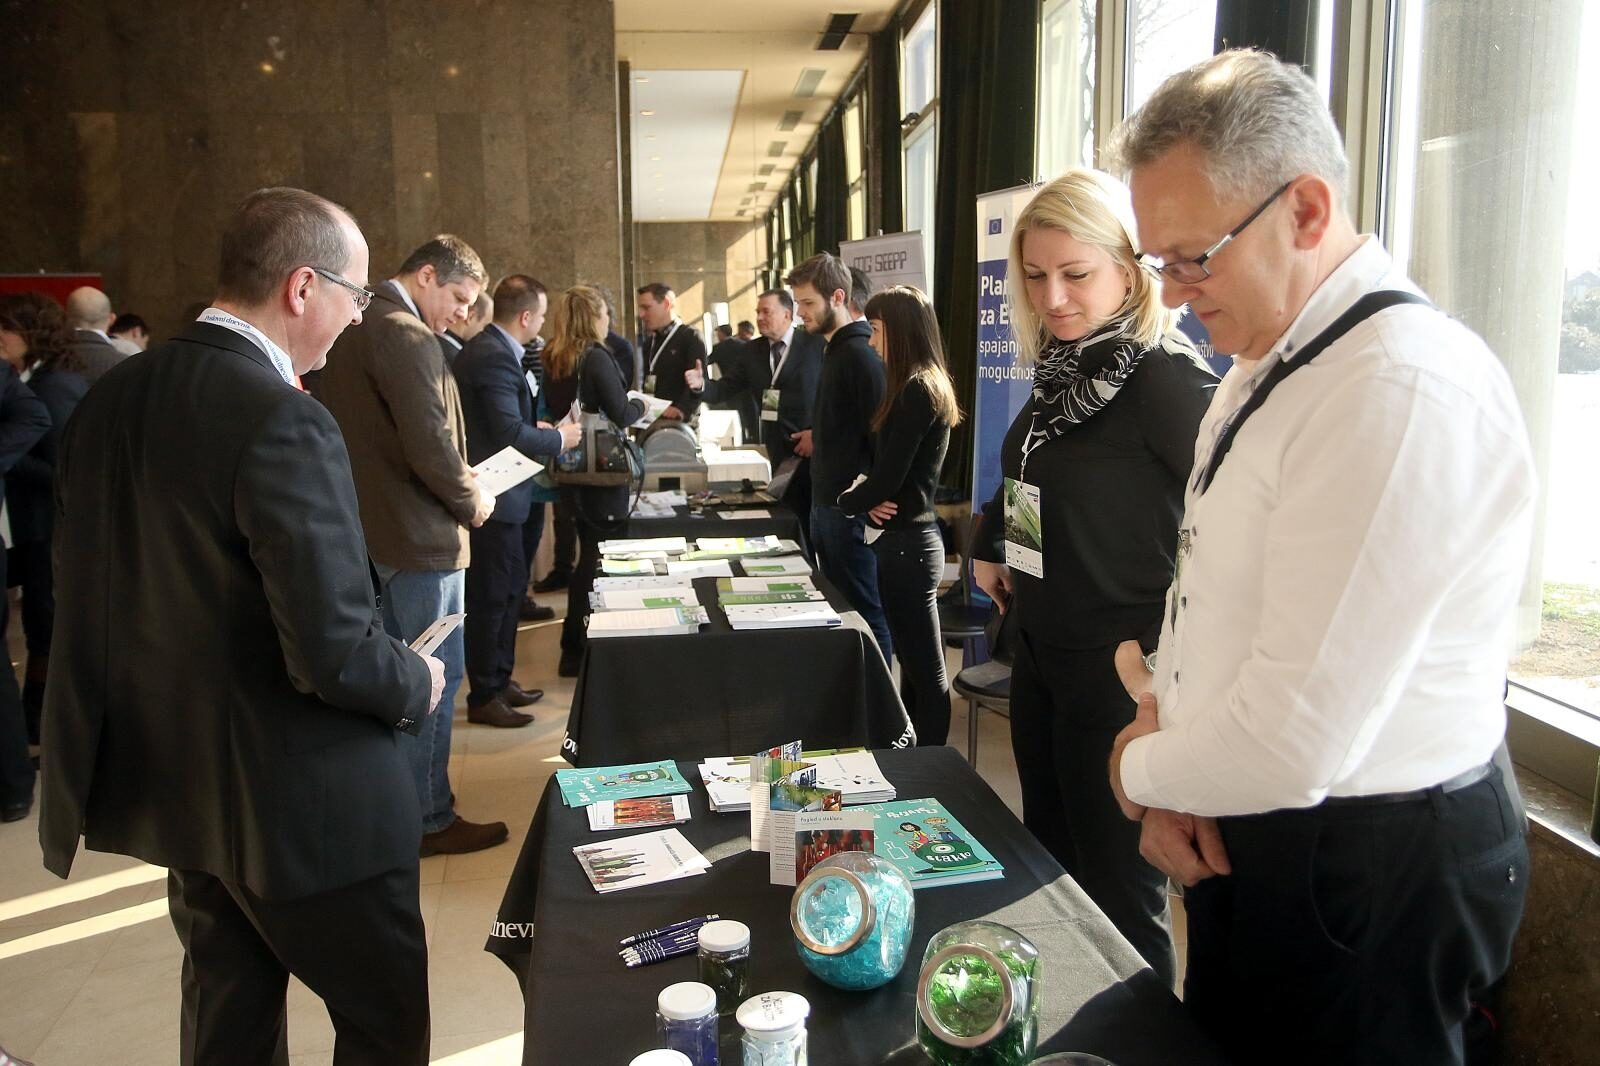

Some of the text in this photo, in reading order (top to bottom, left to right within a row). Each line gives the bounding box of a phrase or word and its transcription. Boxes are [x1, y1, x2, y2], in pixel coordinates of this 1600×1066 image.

[874, 251, 907, 273] SEEPP
[225, 317, 251, 330] dnevnik
[980, 303, 1009, 325] za E
[980, 340, 1022, 358] spajanj
[979, 361, 1035, 384] mogućnos
